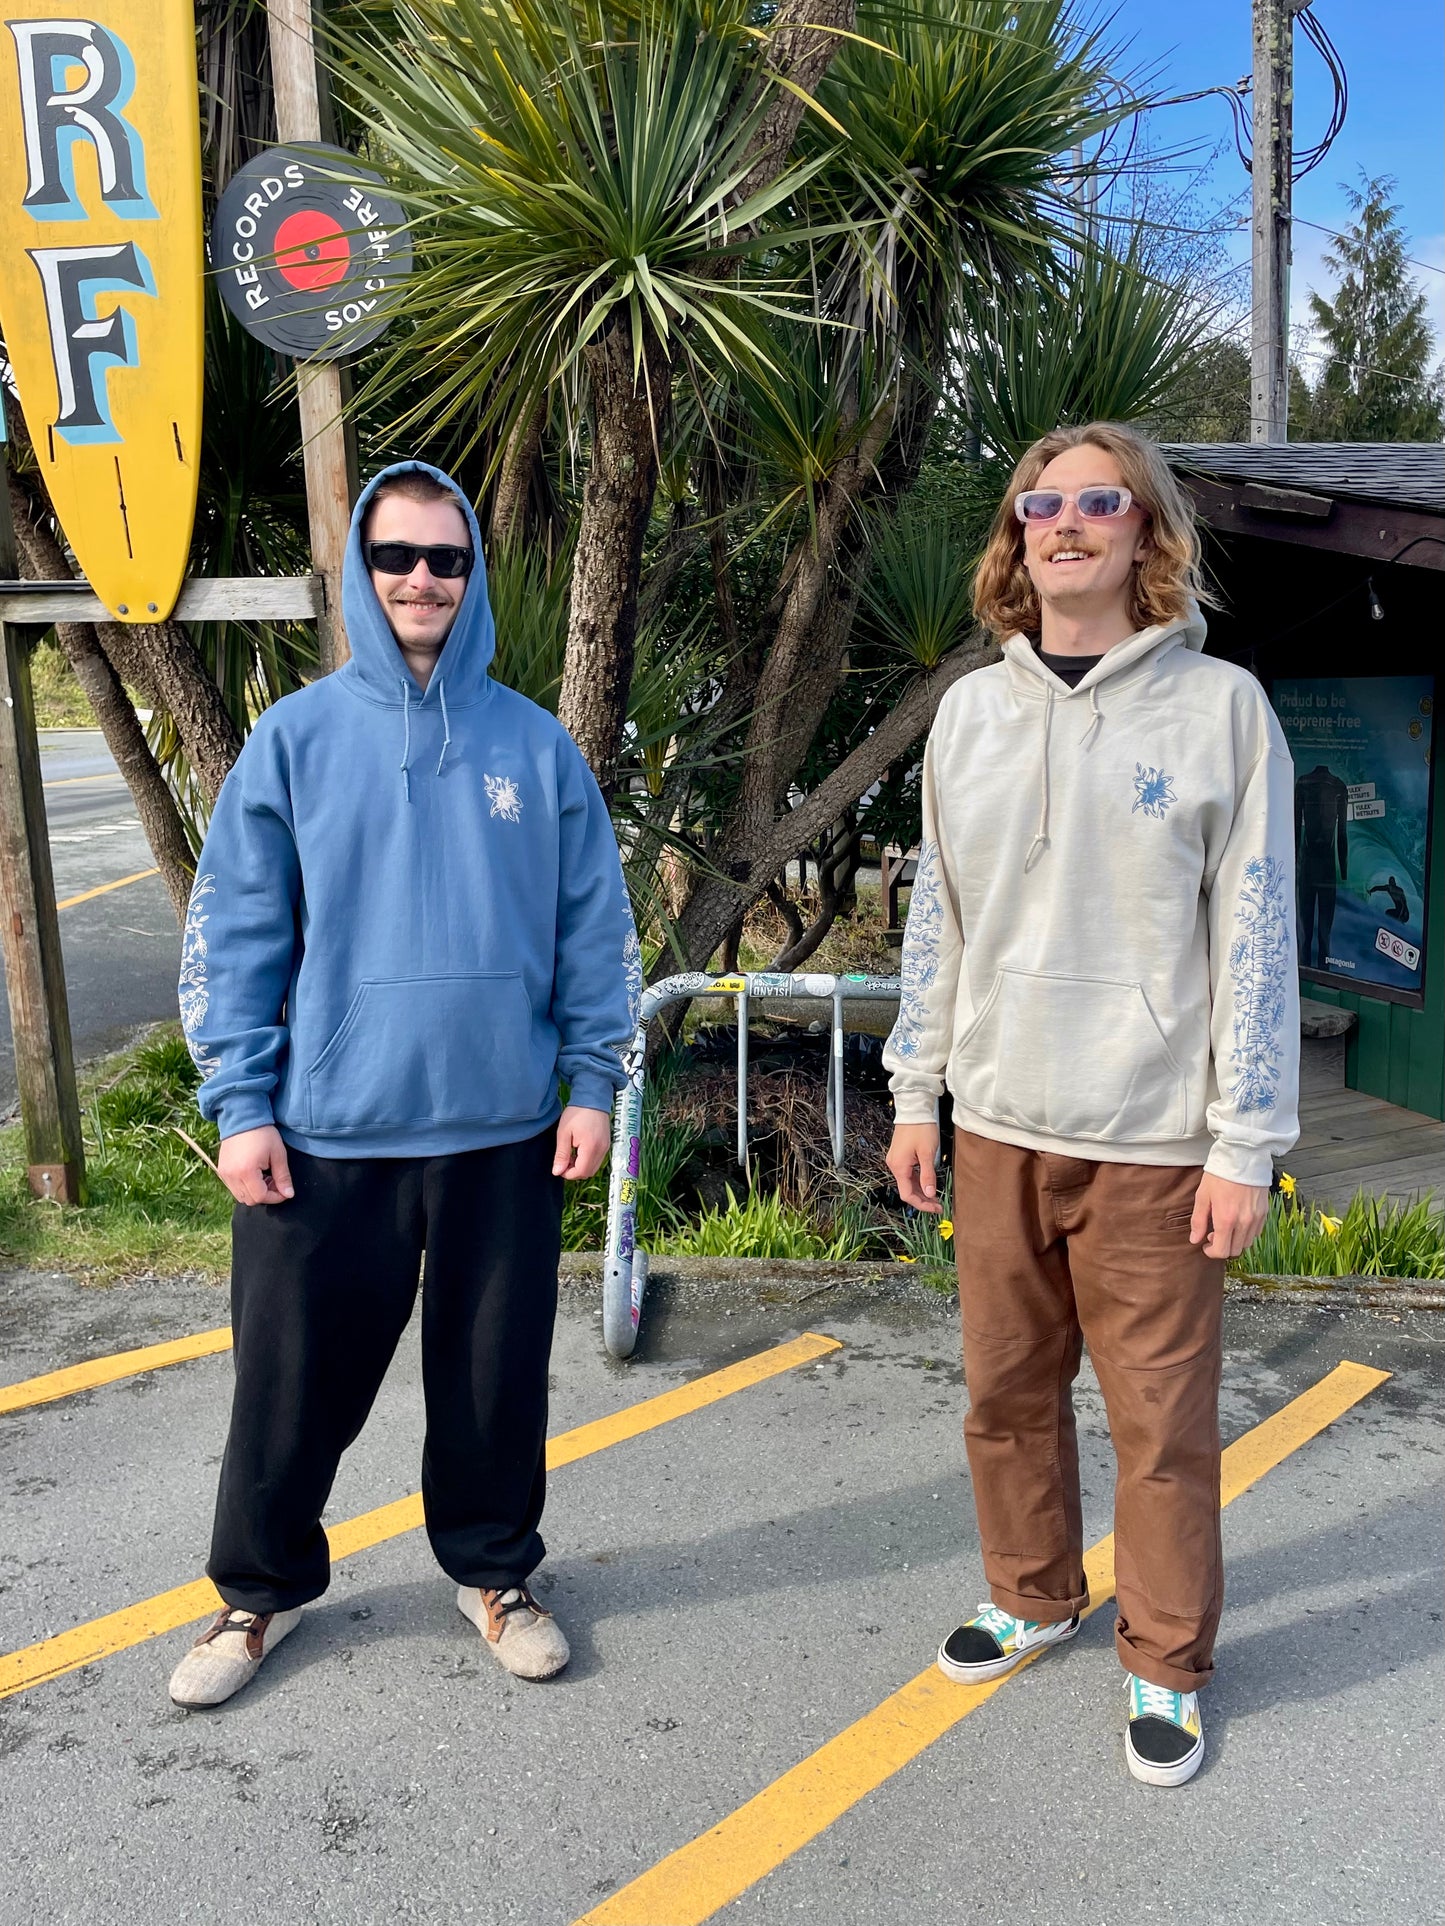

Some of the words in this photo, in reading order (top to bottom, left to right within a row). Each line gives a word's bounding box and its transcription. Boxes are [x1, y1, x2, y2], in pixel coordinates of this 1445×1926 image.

[343, 187, 390, 264] HERE
[233, 165, 304, 310] RECORDS
[1280, 692, 1313, 707] Proud
[1315, 694, 1327, 707] to
[1331, 692, 1346, 708] be
[1280, 713, 1361, 732] neoprene-free
[1325, 956, 1356, 969] patagonia
[753, 986, 788, 998] ISLAND
